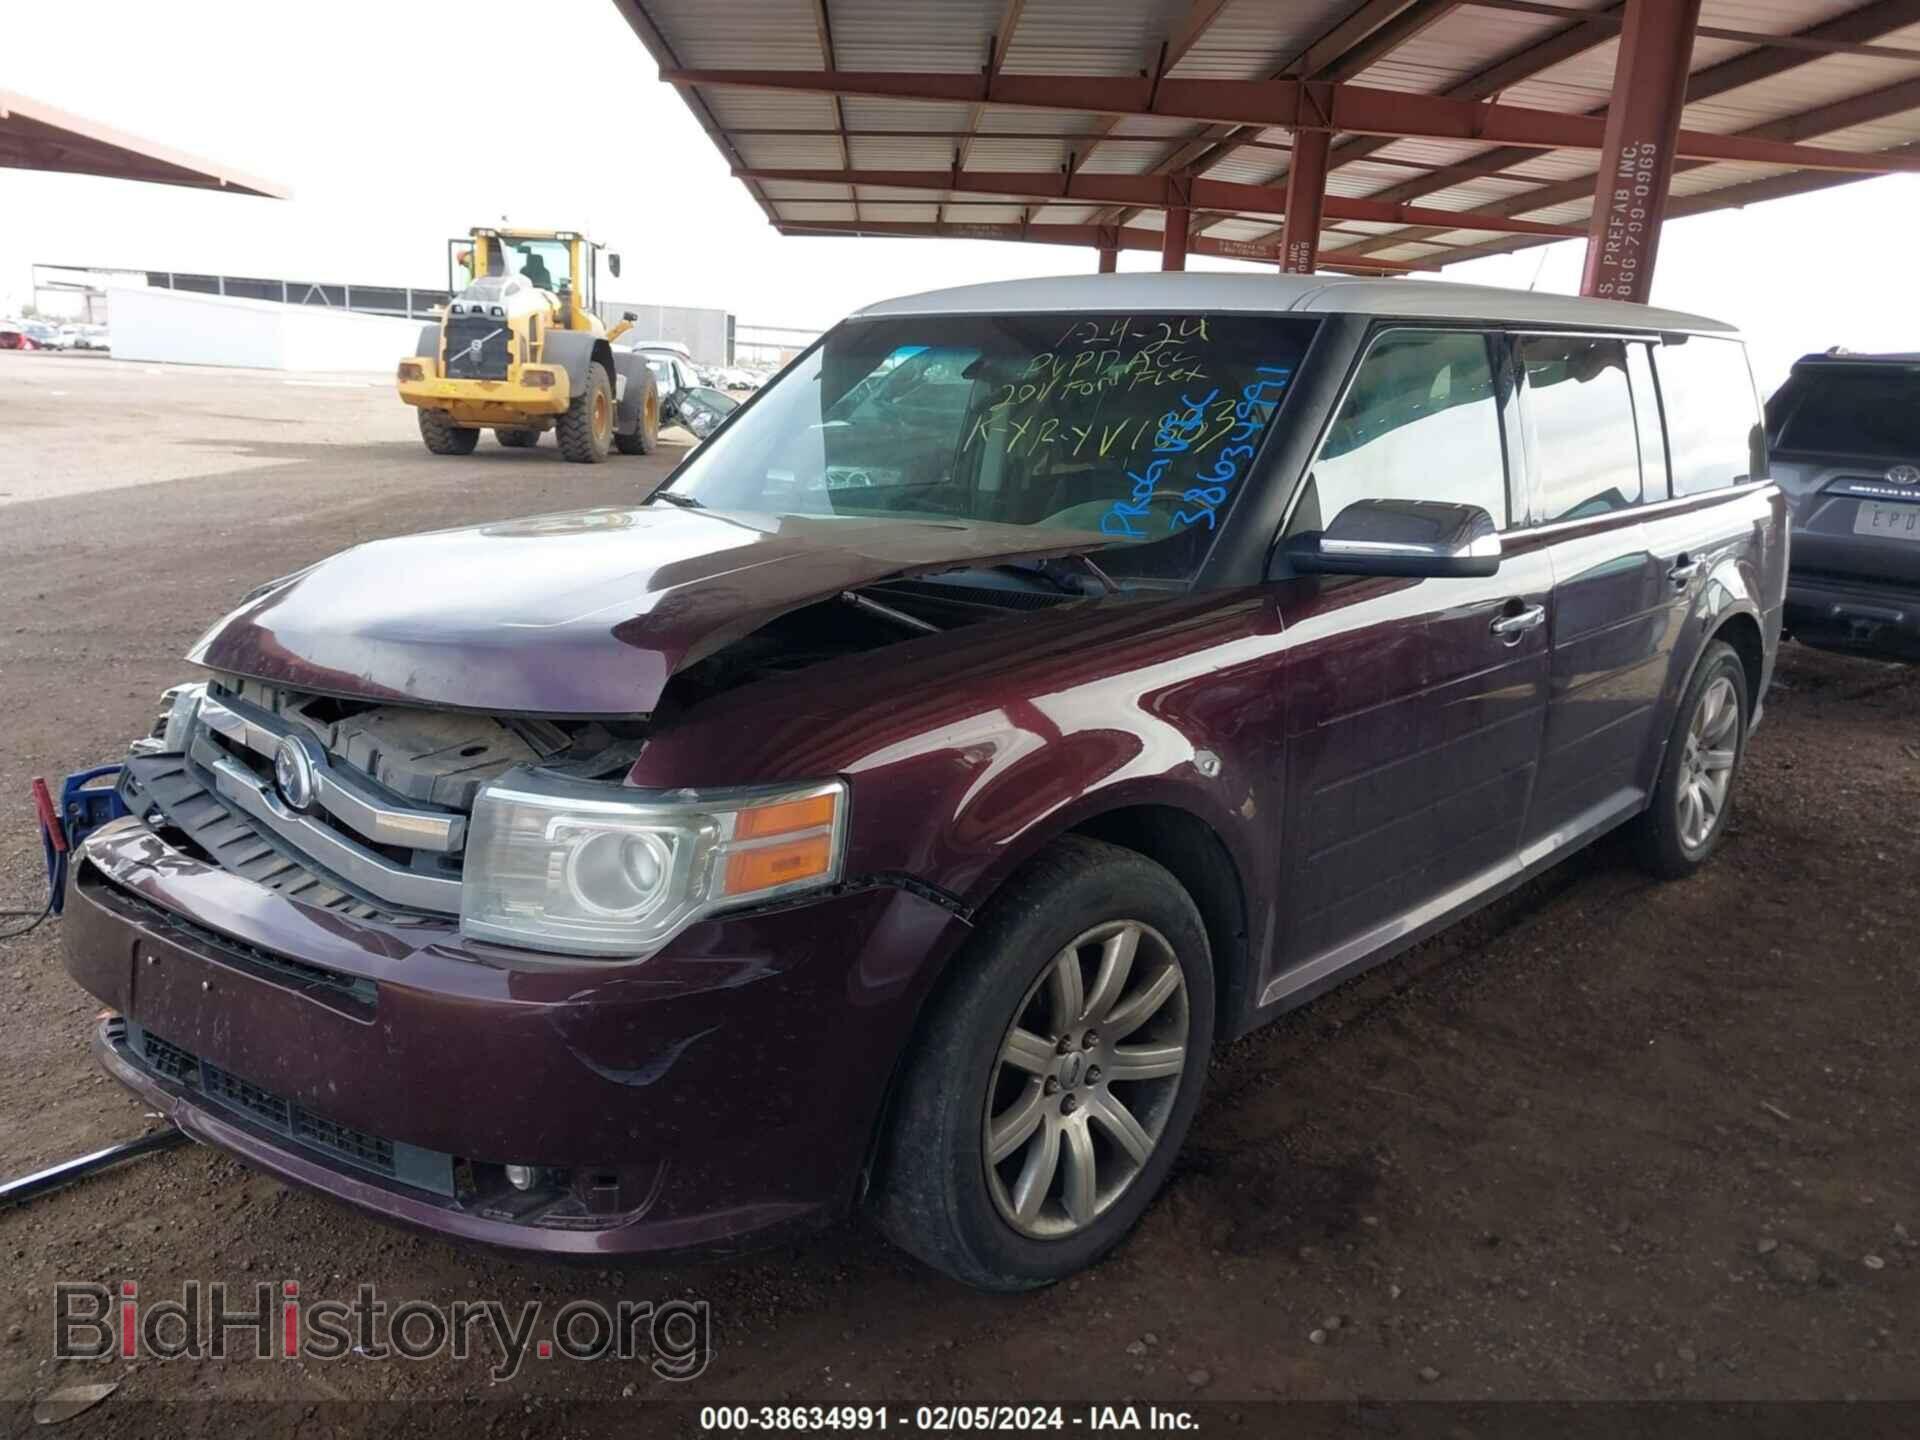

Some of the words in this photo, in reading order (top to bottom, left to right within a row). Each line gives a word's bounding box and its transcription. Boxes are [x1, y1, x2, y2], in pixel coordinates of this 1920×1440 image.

[1603, 189, 1630, 266] PREFAB
[1618, 140, 1640, 178] INC.
[1169, 365, 1291, 531] 38634991
